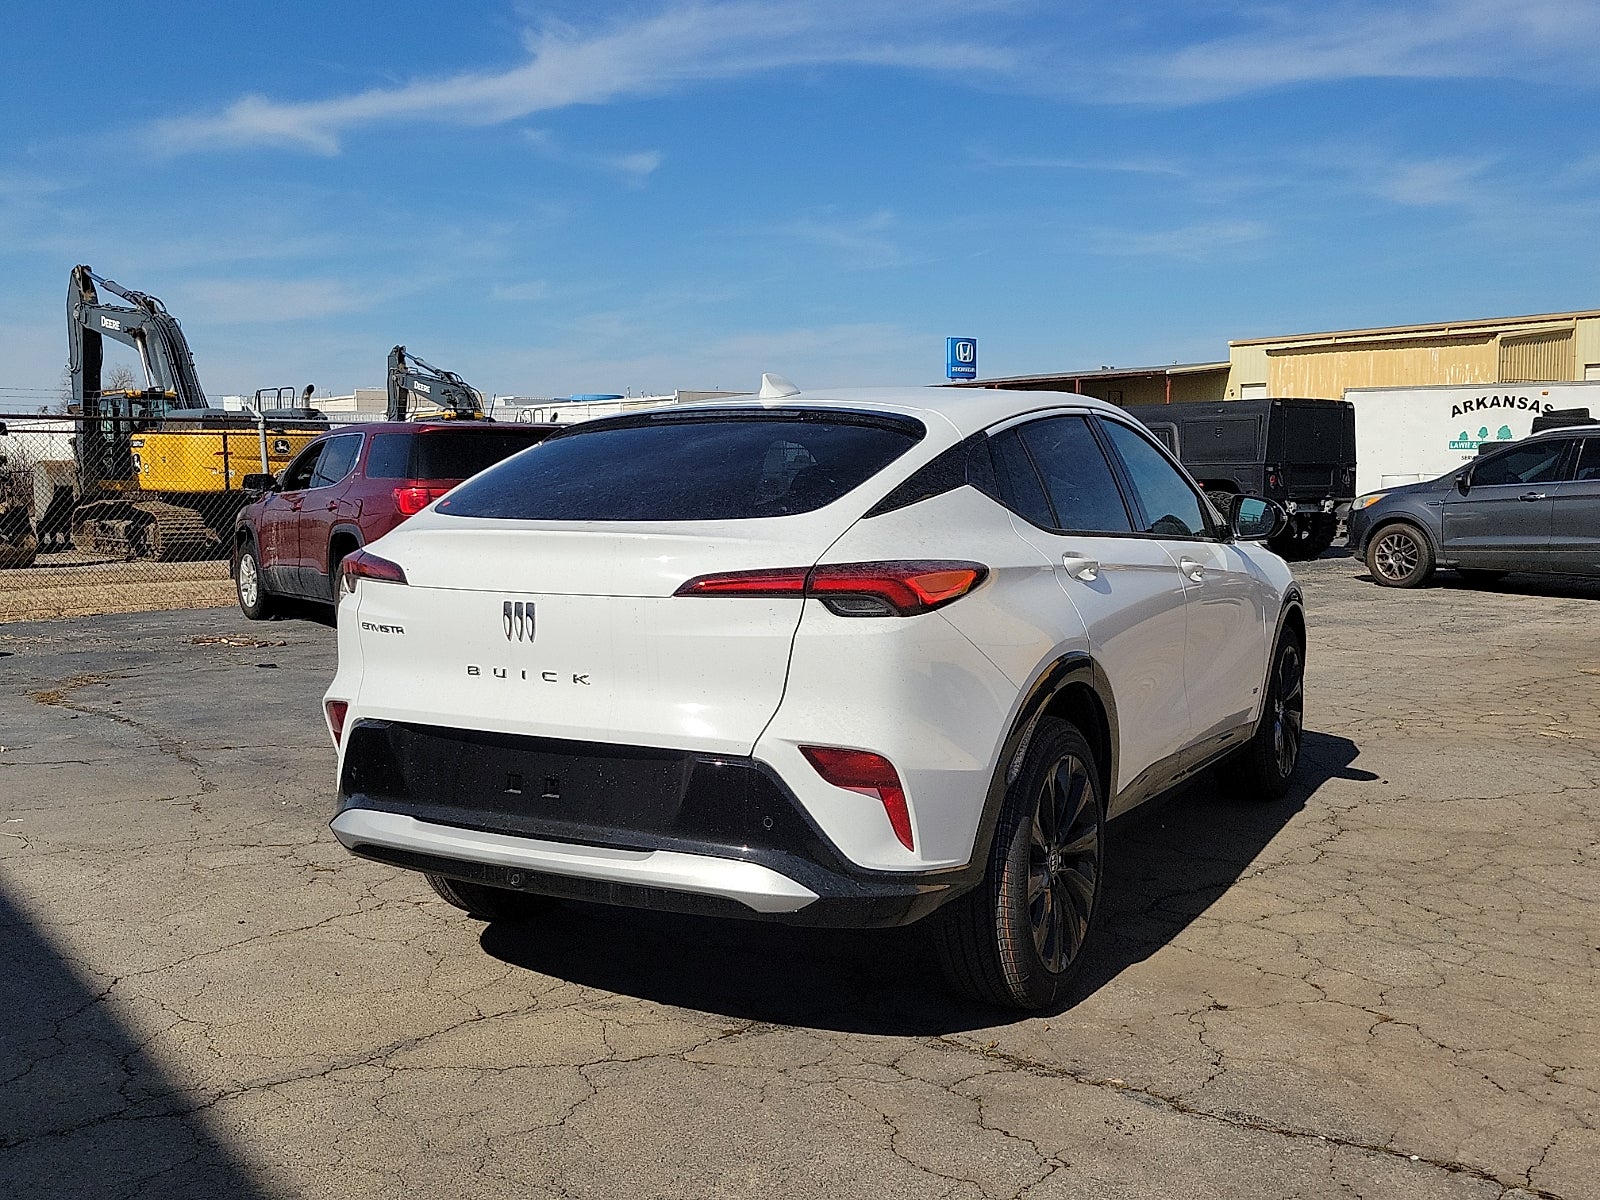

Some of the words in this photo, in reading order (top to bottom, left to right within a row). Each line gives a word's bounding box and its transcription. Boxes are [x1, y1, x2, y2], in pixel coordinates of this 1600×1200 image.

[100, 315, 121, 331] DEERE
[413, 380, 431, 394] DEERE
[1451, 395, 1555, 418] ARKANSAS
[361, 621, 406, 635] ENVISTA
[467, 665, 591, 686] BUICK
